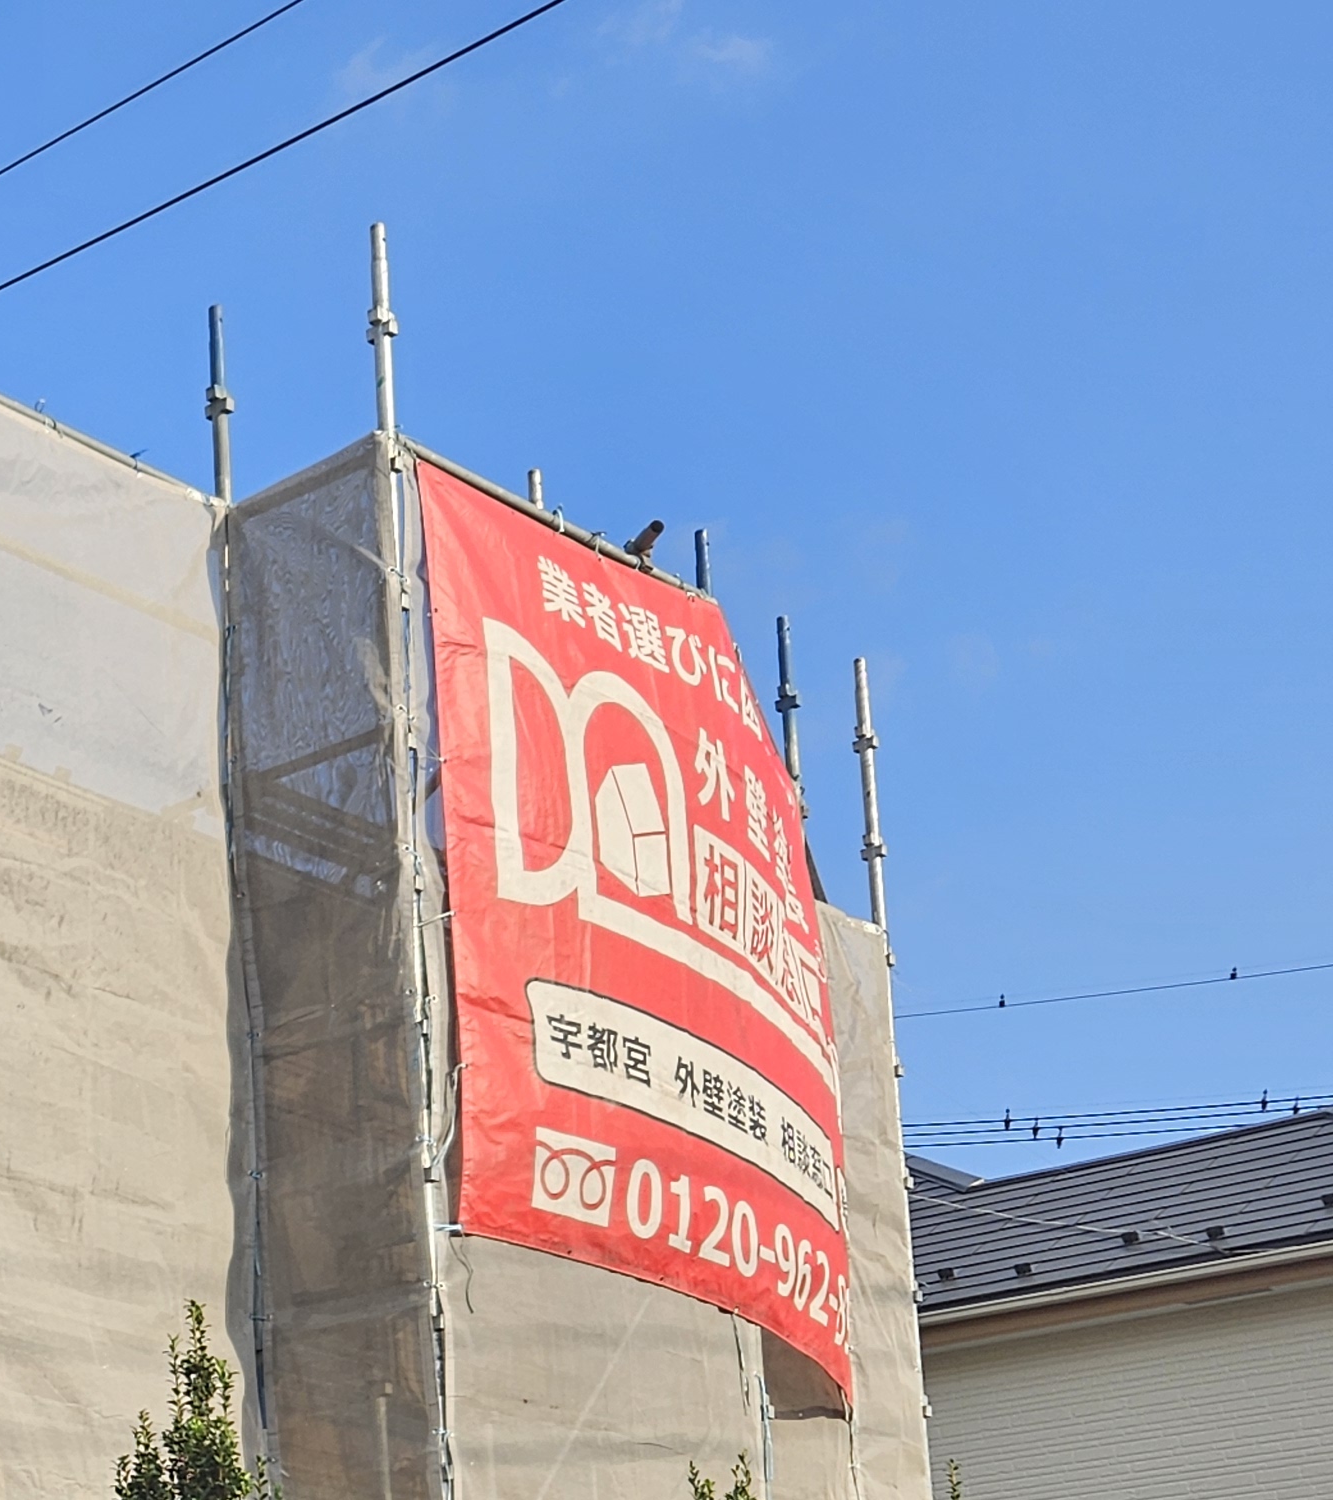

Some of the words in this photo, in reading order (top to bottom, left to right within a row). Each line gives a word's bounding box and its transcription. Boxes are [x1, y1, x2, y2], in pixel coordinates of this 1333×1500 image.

[546, 1014, 652, 1088] 宇都宮
[674, 1056, 769, 1147] 外壁塗装
